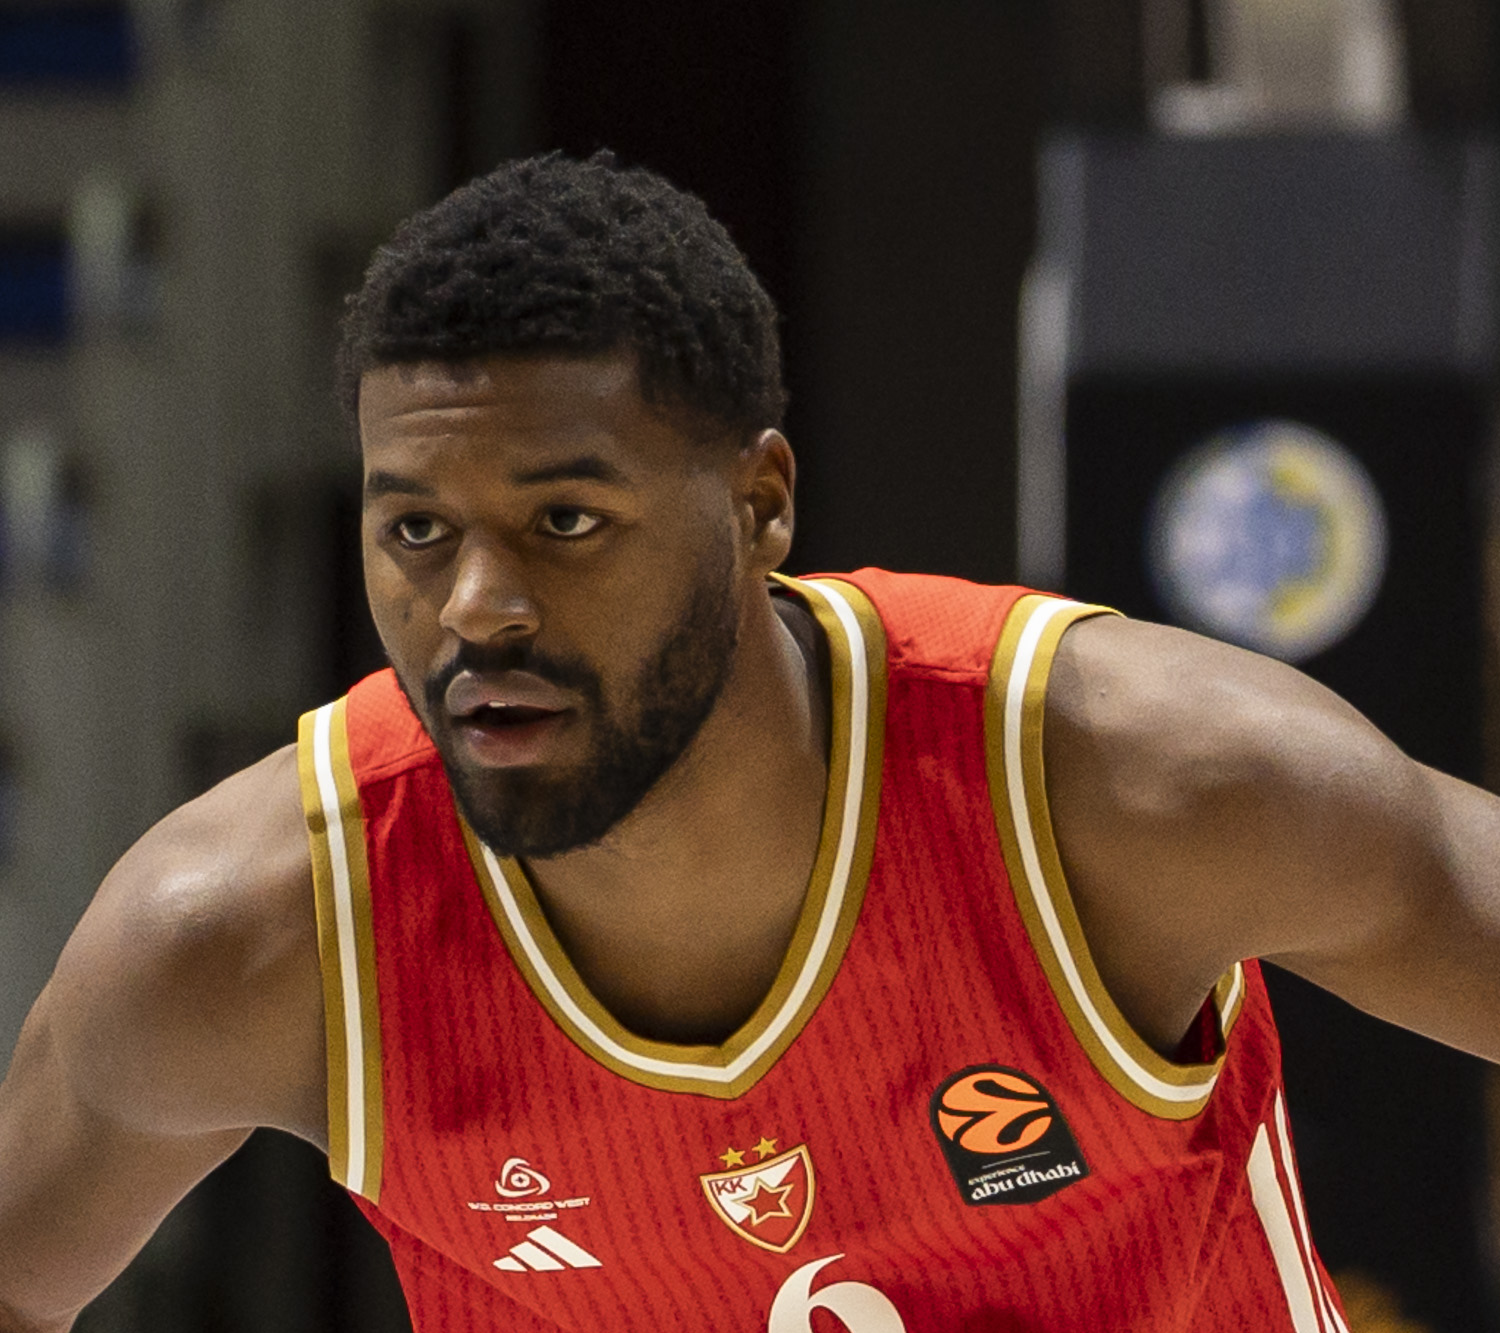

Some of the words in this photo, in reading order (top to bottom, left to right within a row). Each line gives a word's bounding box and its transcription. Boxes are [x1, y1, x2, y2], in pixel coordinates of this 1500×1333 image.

[968, 1164, 1025, 1185] experience
[971, 1177, 1016, 1201] abu
[1015, 1160, 1082, 1187] dhabi
